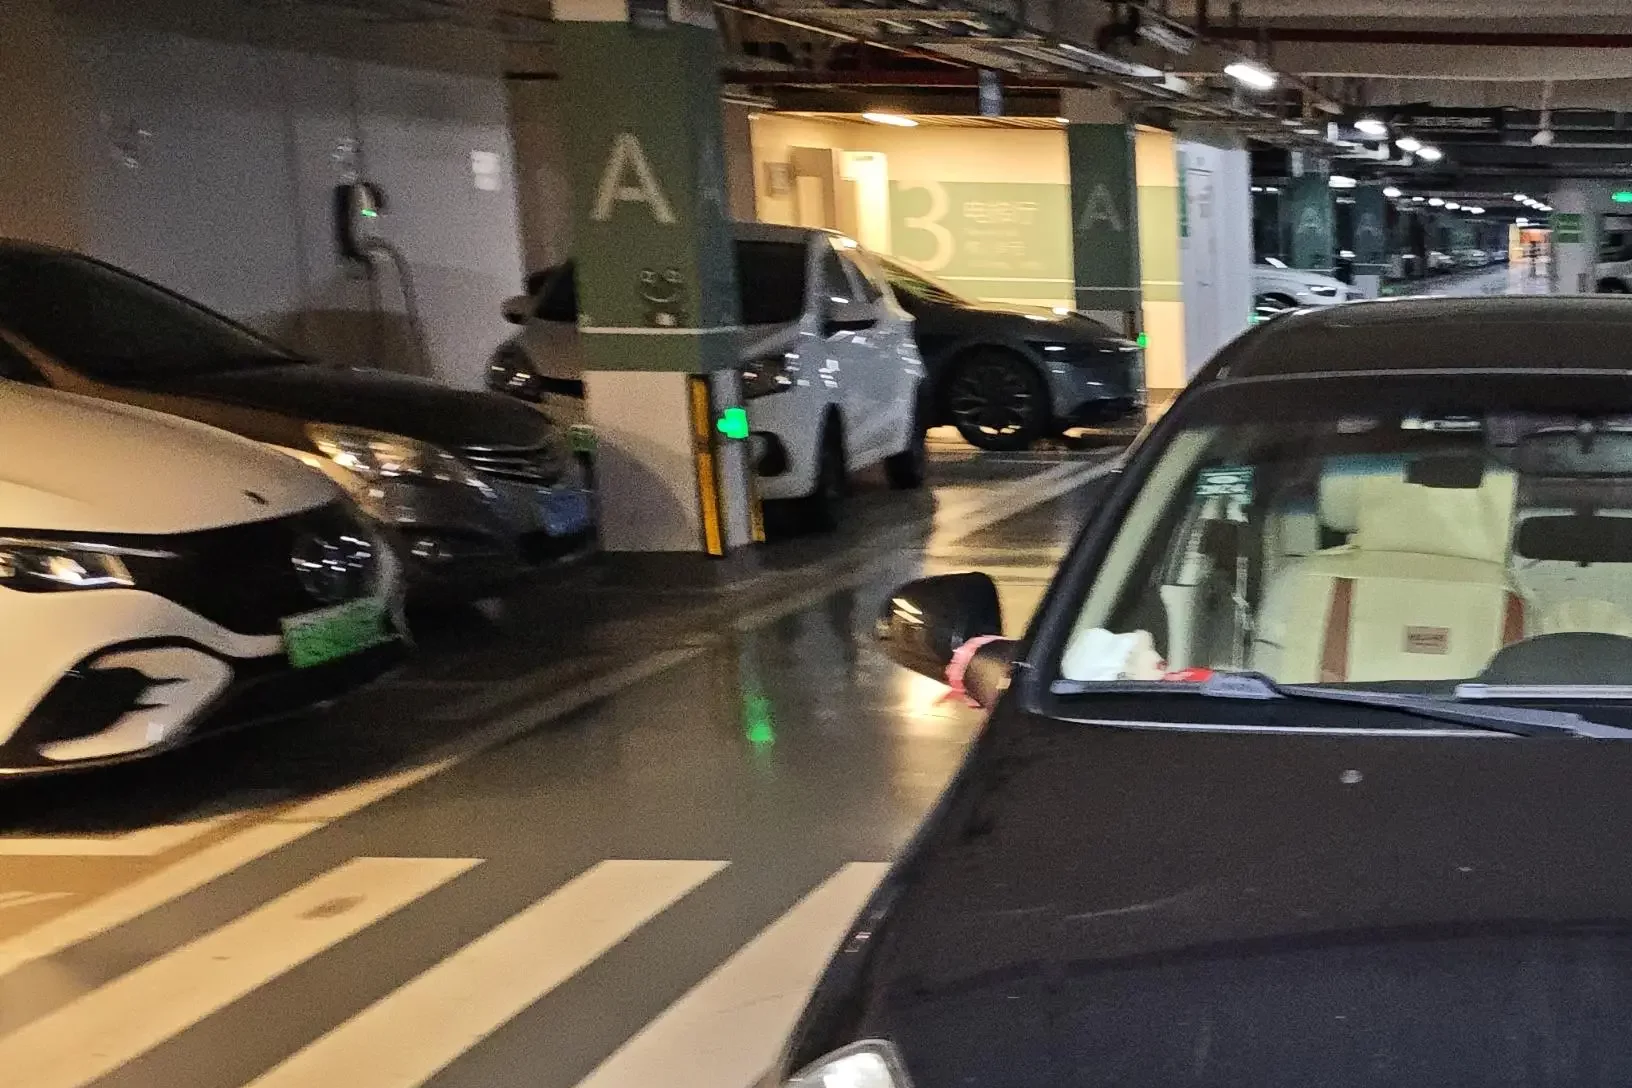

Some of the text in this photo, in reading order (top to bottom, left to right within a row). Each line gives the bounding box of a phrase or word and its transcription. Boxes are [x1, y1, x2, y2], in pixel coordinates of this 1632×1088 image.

[590, 132, 677, 224] A
[1078, 183, 1124, 233] A
[897, 179, 956, 272] 3
